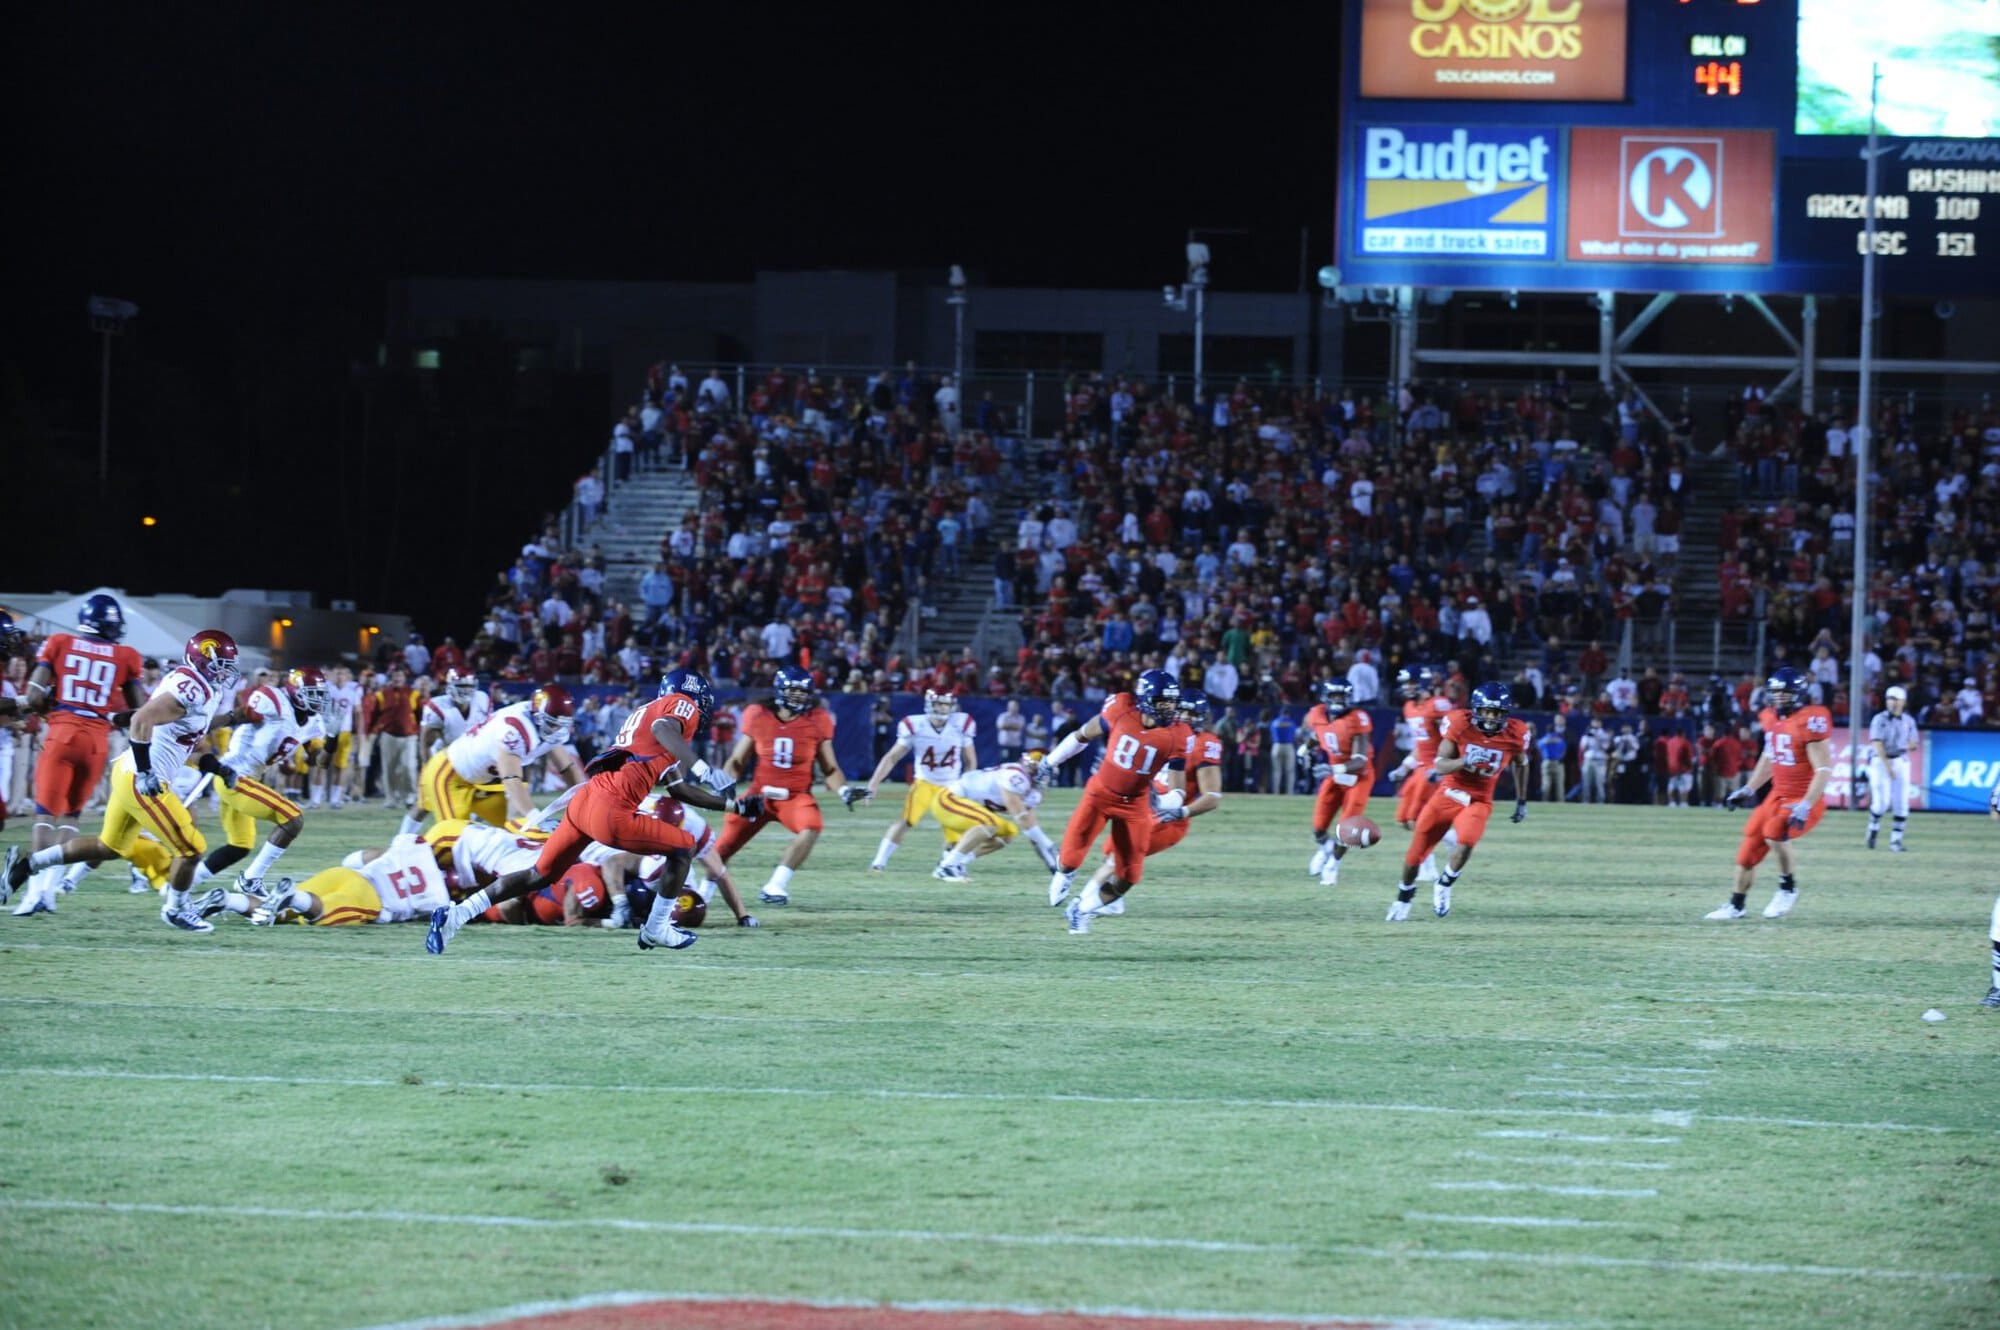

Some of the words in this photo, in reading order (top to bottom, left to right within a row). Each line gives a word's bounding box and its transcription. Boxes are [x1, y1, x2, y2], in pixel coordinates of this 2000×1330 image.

[1410, 22, 1583, 59] CASINOS
[1695, 61, 1741, 95] 44
[1365, 128, 1550, 195] Budget
[1901, 142, 2000, 161] ARIZONA
[1936, 196, 1980, 220] 100
[1368, 235, 1396, 249] car
[1404, 233, 1435, 249] and
[1442, 231, 1487, 249] truck
[1495, 233, 1541, 250] sales
[1580, 240, 1621, 255] What
[1936, 232, 1976, 256] 151
[61, 653, 116, 707] 29
[177, 679, 201, 702] 45
[673, 699, 695, 721] 89
[772, 737, 794, 769] 8
[920, 745, 957, 772] 44
[1113, 734, 1158, 775] 81
[1932, 760, 2000, 788] ARI
